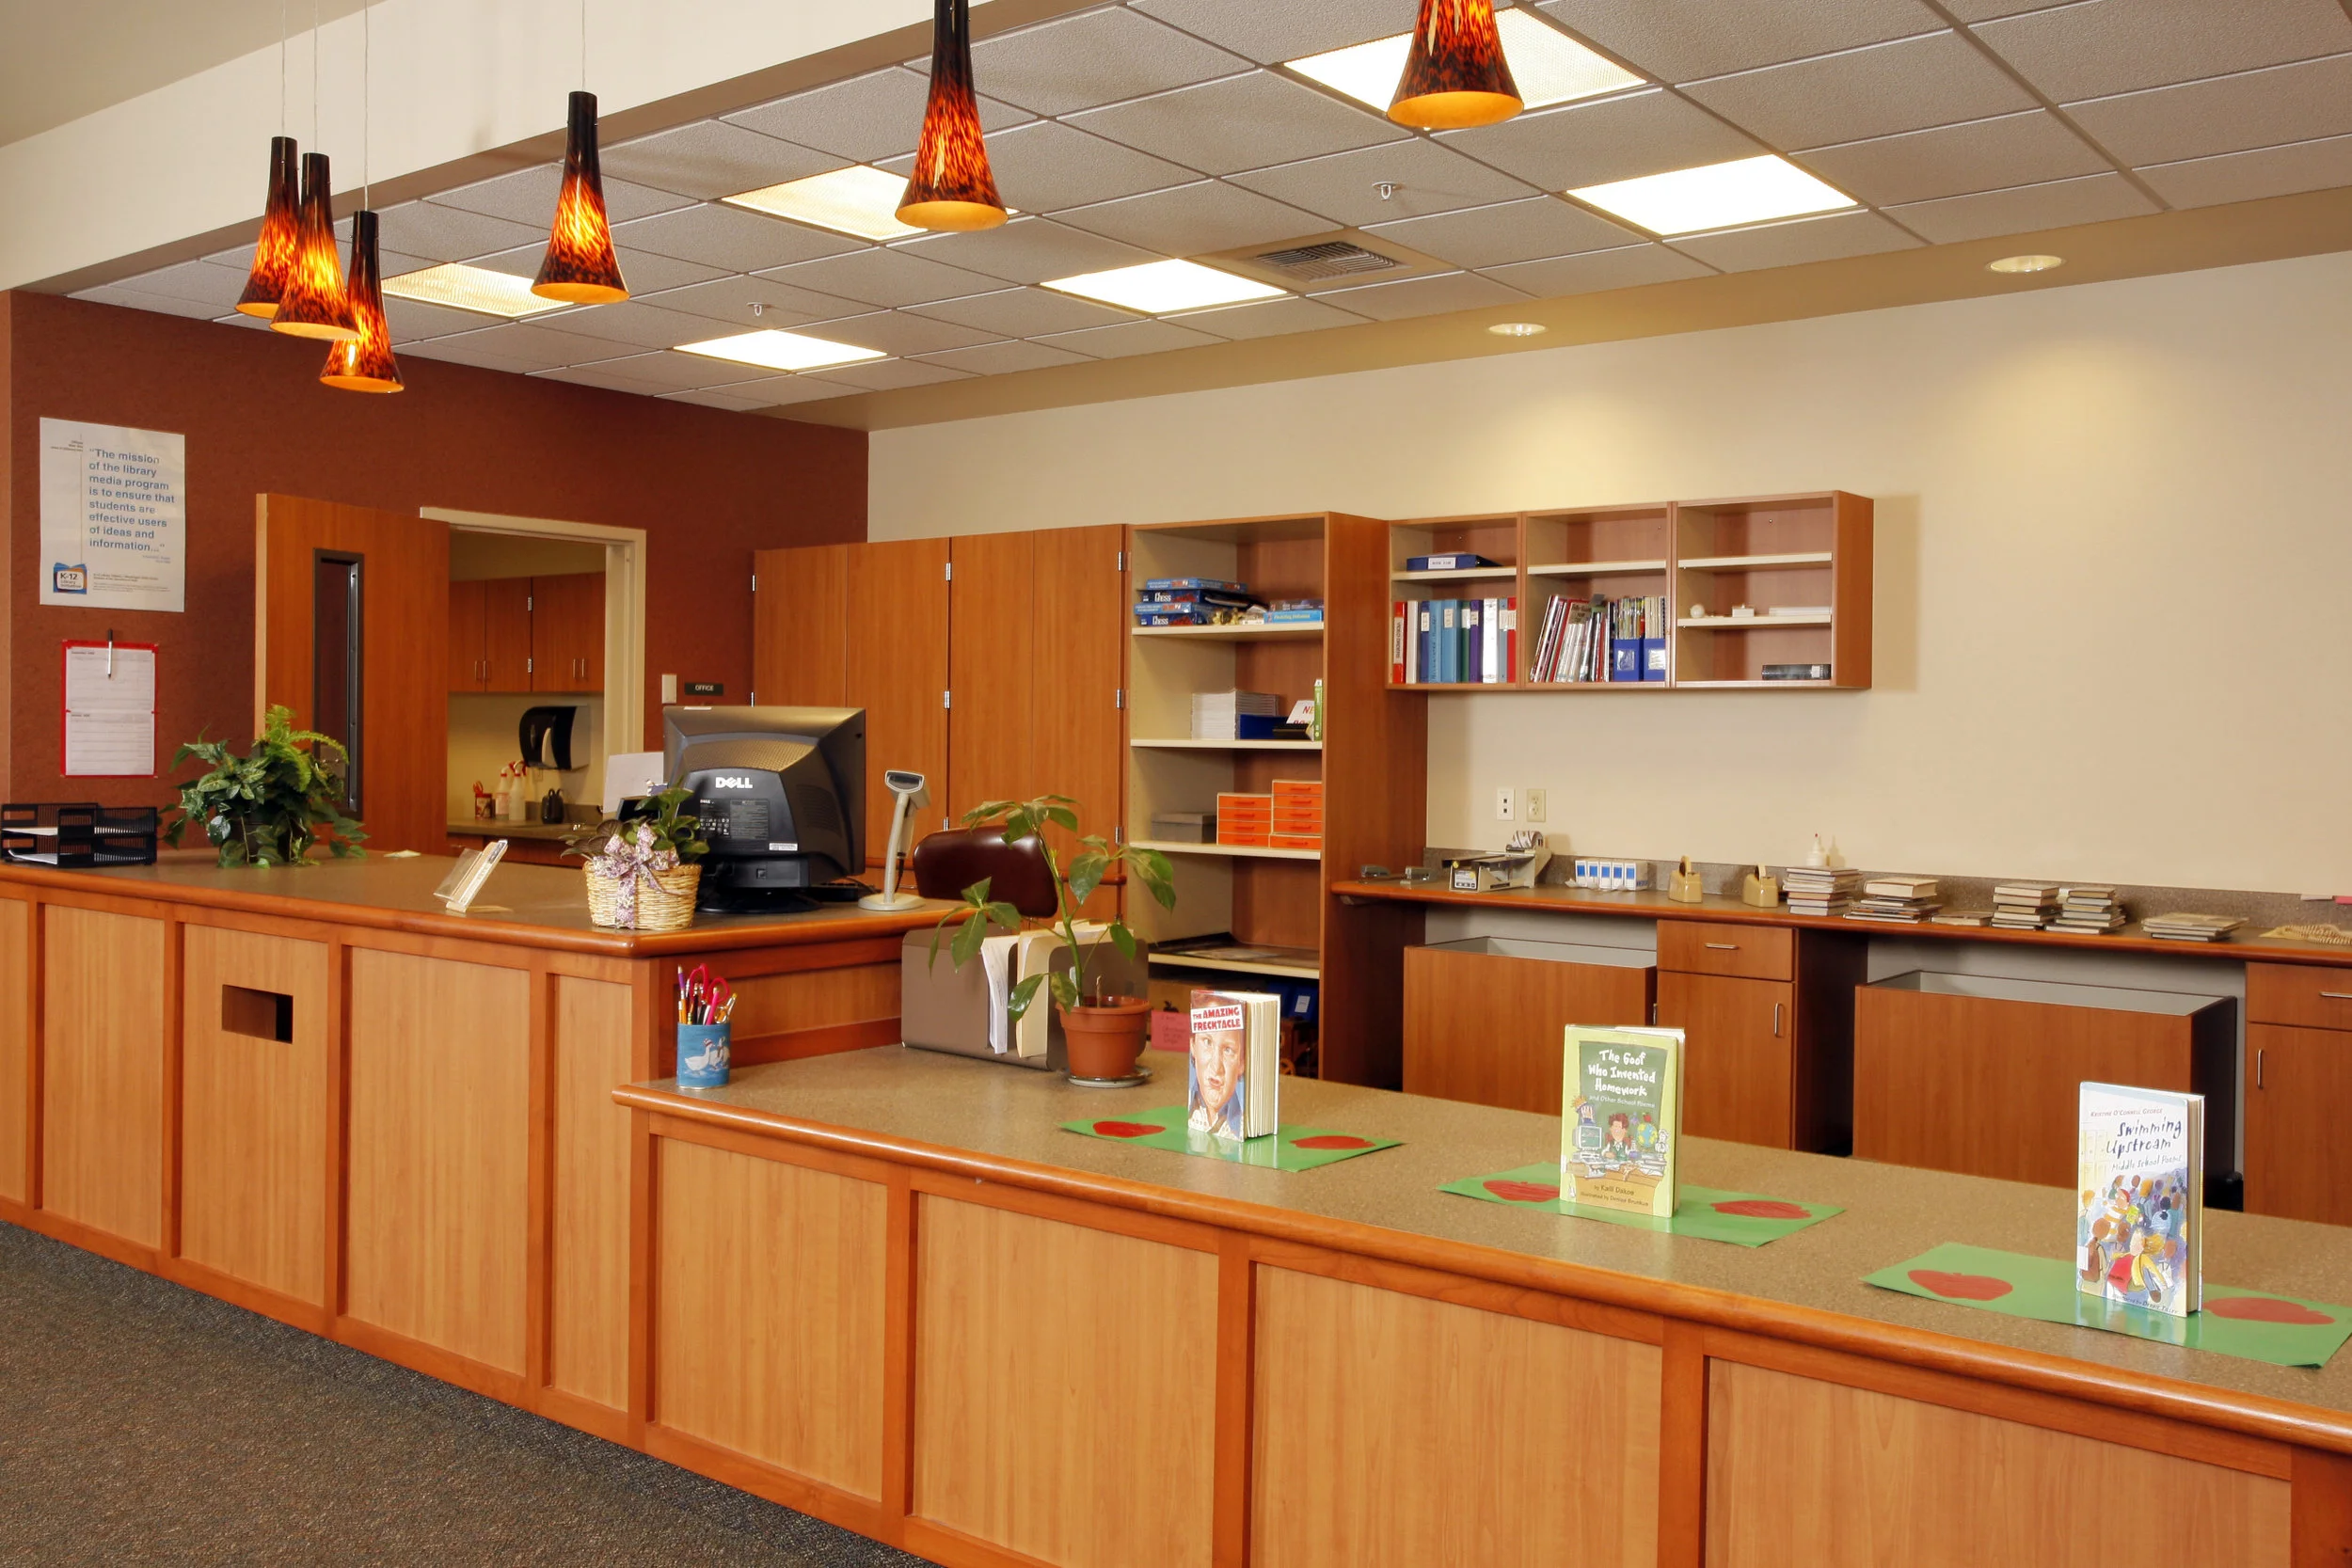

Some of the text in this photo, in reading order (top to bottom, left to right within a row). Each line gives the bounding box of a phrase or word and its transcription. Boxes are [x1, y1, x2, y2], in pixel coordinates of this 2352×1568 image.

[119, 452, 160, 464] mission
[89, 462, 156, 478] of the library
[89, 475, 169, 490] media program
[89, 487, 98, 496] is
[116, 491, 151, 500] ensure
[155, 494, 174, 503] that
[89, 500, 135, 512] students
[89, 514, 135, 524] effective
[103, 527, 132, 536] ideas
[135, 531, 154, 539] and
[715, 777, 753, 789] DELL
[1203, 1007, 1239, 1019] AMAZING
[1194, 1019, 1241, 1031] FRECKTACLE
[1599, 1050, 1646, 1065] The Goof
[1588, 1064, 1656, 1084] Who Invented
[1596, 1078, 1647, 1097] Homework
[2117, 1116, 2181, 1139] Swimming
[2106, 1138, 2170, 1159] Upstream
[2111, 1155, 2182, 1172] Middle School Poems
